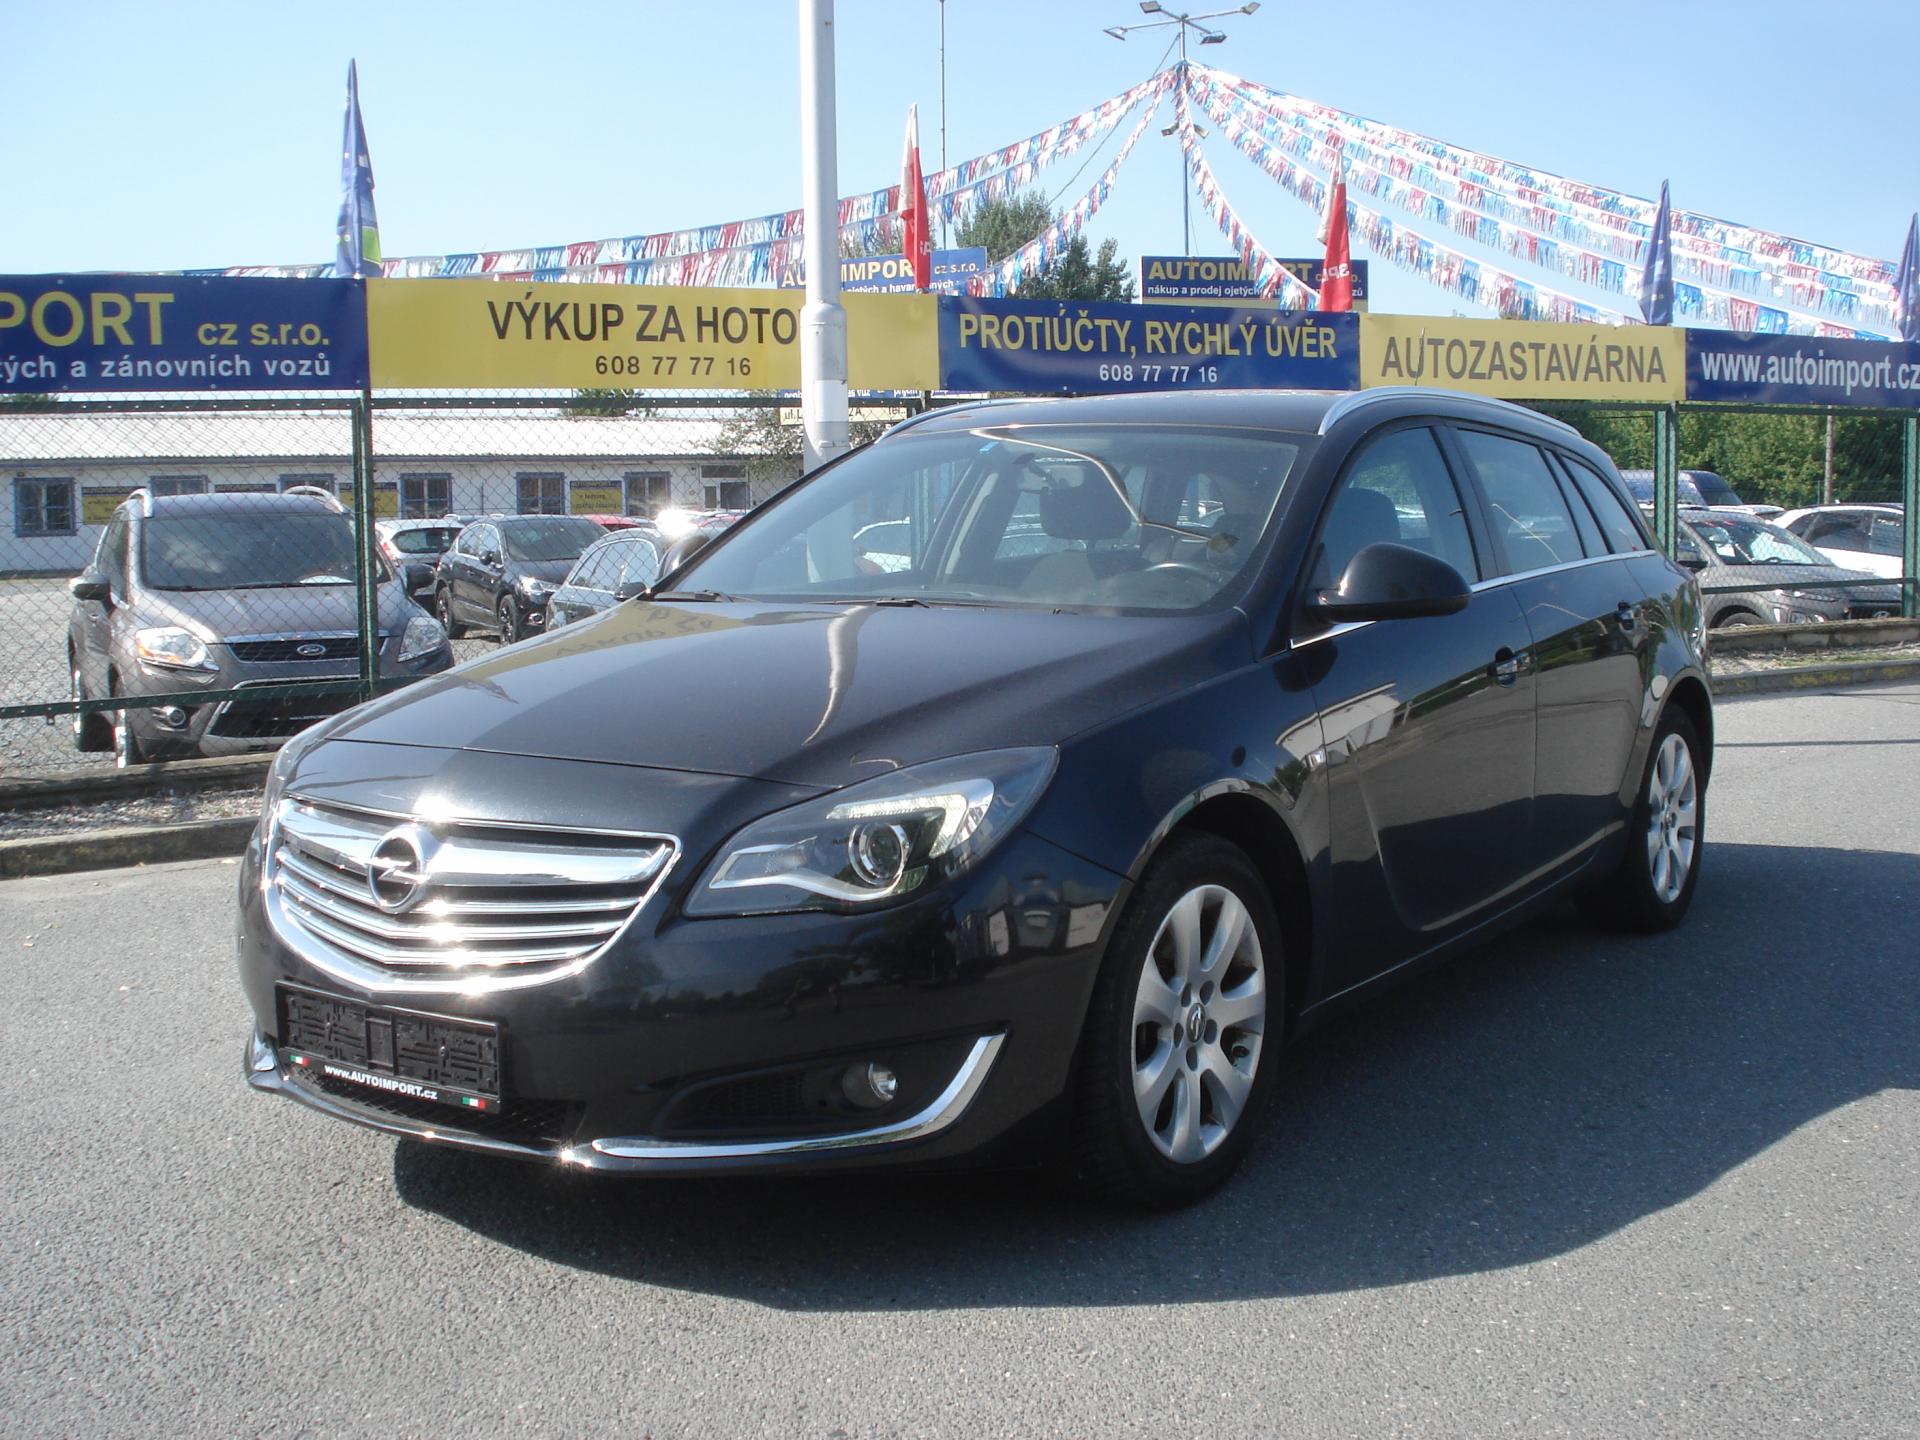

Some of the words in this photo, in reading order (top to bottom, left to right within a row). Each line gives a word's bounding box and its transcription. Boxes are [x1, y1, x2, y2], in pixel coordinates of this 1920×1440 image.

[1148, 284, 1178, 297] nákup
[1181, 287, 1188, 295] a
[1190, 284, 1222, 298] prodej
[1224, 284, 1260, 298] ojetých
[0, 291, 175, 347] PORT
[197, 322, 239, 346] cz
[250, 322, 331, 346] s.r.o.
[487, 291, 625, 342] VÝKUP
[635, 304, 686, 343] ZA
[959, 308, 1137, 359] PROTIÚČTY,
[1146, 315, 1257, 358] RYCHLÝ
[1265, 316, 1338, 359] ÚVĚR
[70, 359, 87, 378] a
[101, 354, 251, 378] zánovních
[264, 352, 331, 377] vozů
[595, 355, 640, 376] 608
[652, 356, 678, 376] 77
[689, 357, 715, 376] 77
[727, 357, 751, 377] 16
[1099, 364, 1133, 382] 608
[1142, 365, 1162, 383] 77
[1170, 366, 1189, 383] 77
[1199, 366, 1218, 384] 16
[1381, 334, 1668, 384] AUTOZASTAVÁRNA
[1701, 349, 1920, 396] www.autoimport.cz
